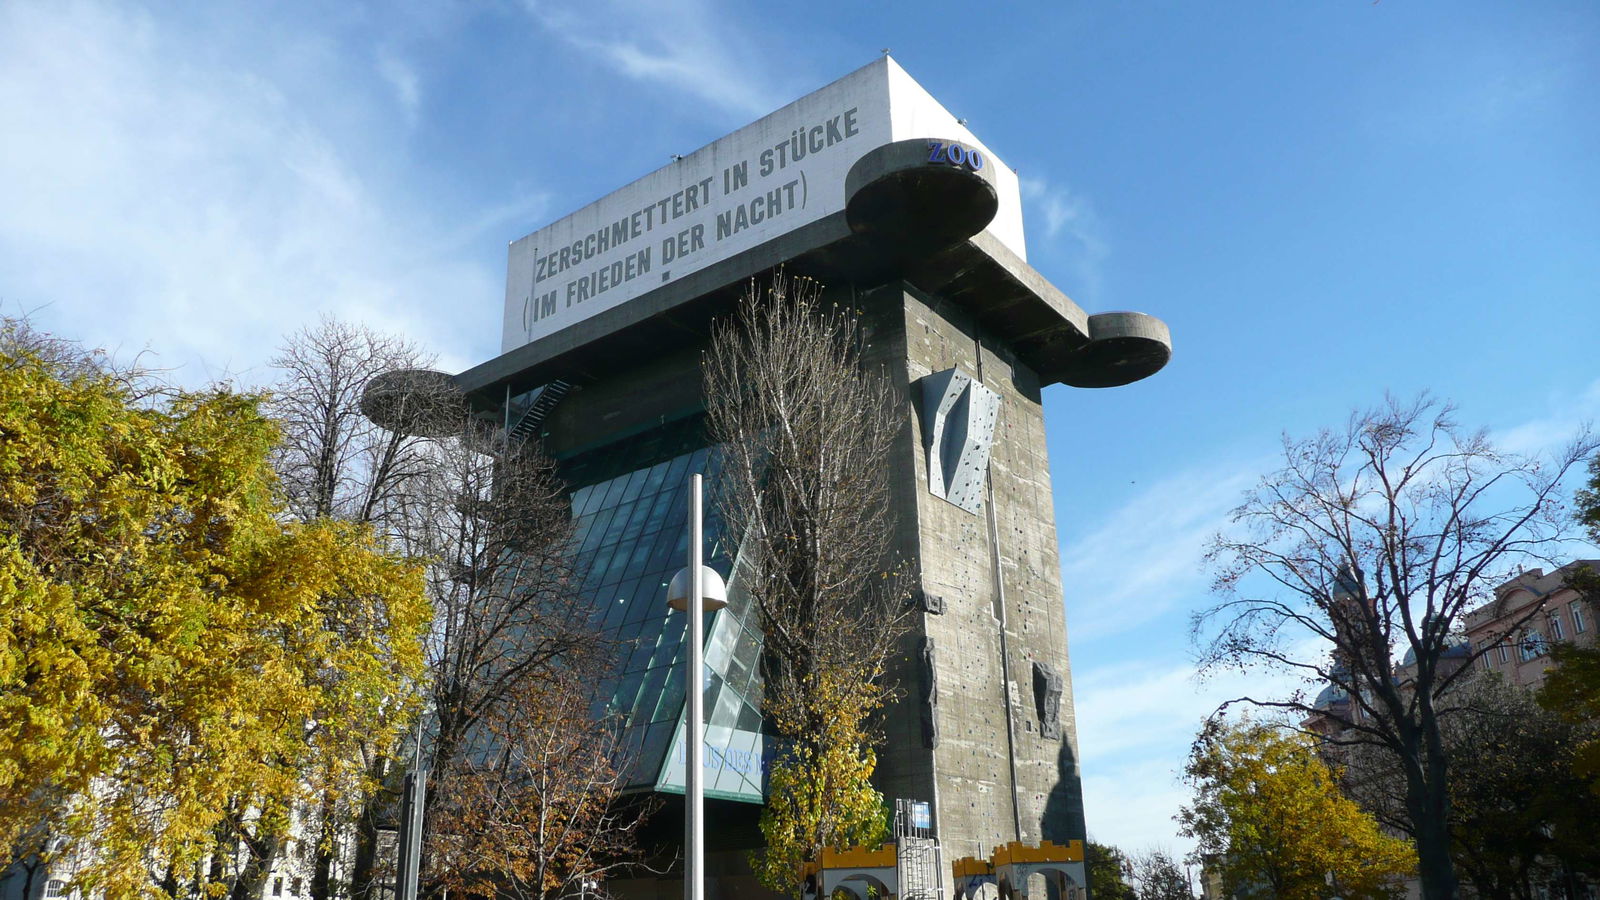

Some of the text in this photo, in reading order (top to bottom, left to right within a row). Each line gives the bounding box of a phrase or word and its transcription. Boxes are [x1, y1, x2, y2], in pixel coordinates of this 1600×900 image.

[535, 107, 859, 283] ZERSCHMETTERT IN STÜCKE
[928, 142, 984, 172] ZOO
[522, 170, 808, 332] (IM FRIEDEN DER NACHT)
